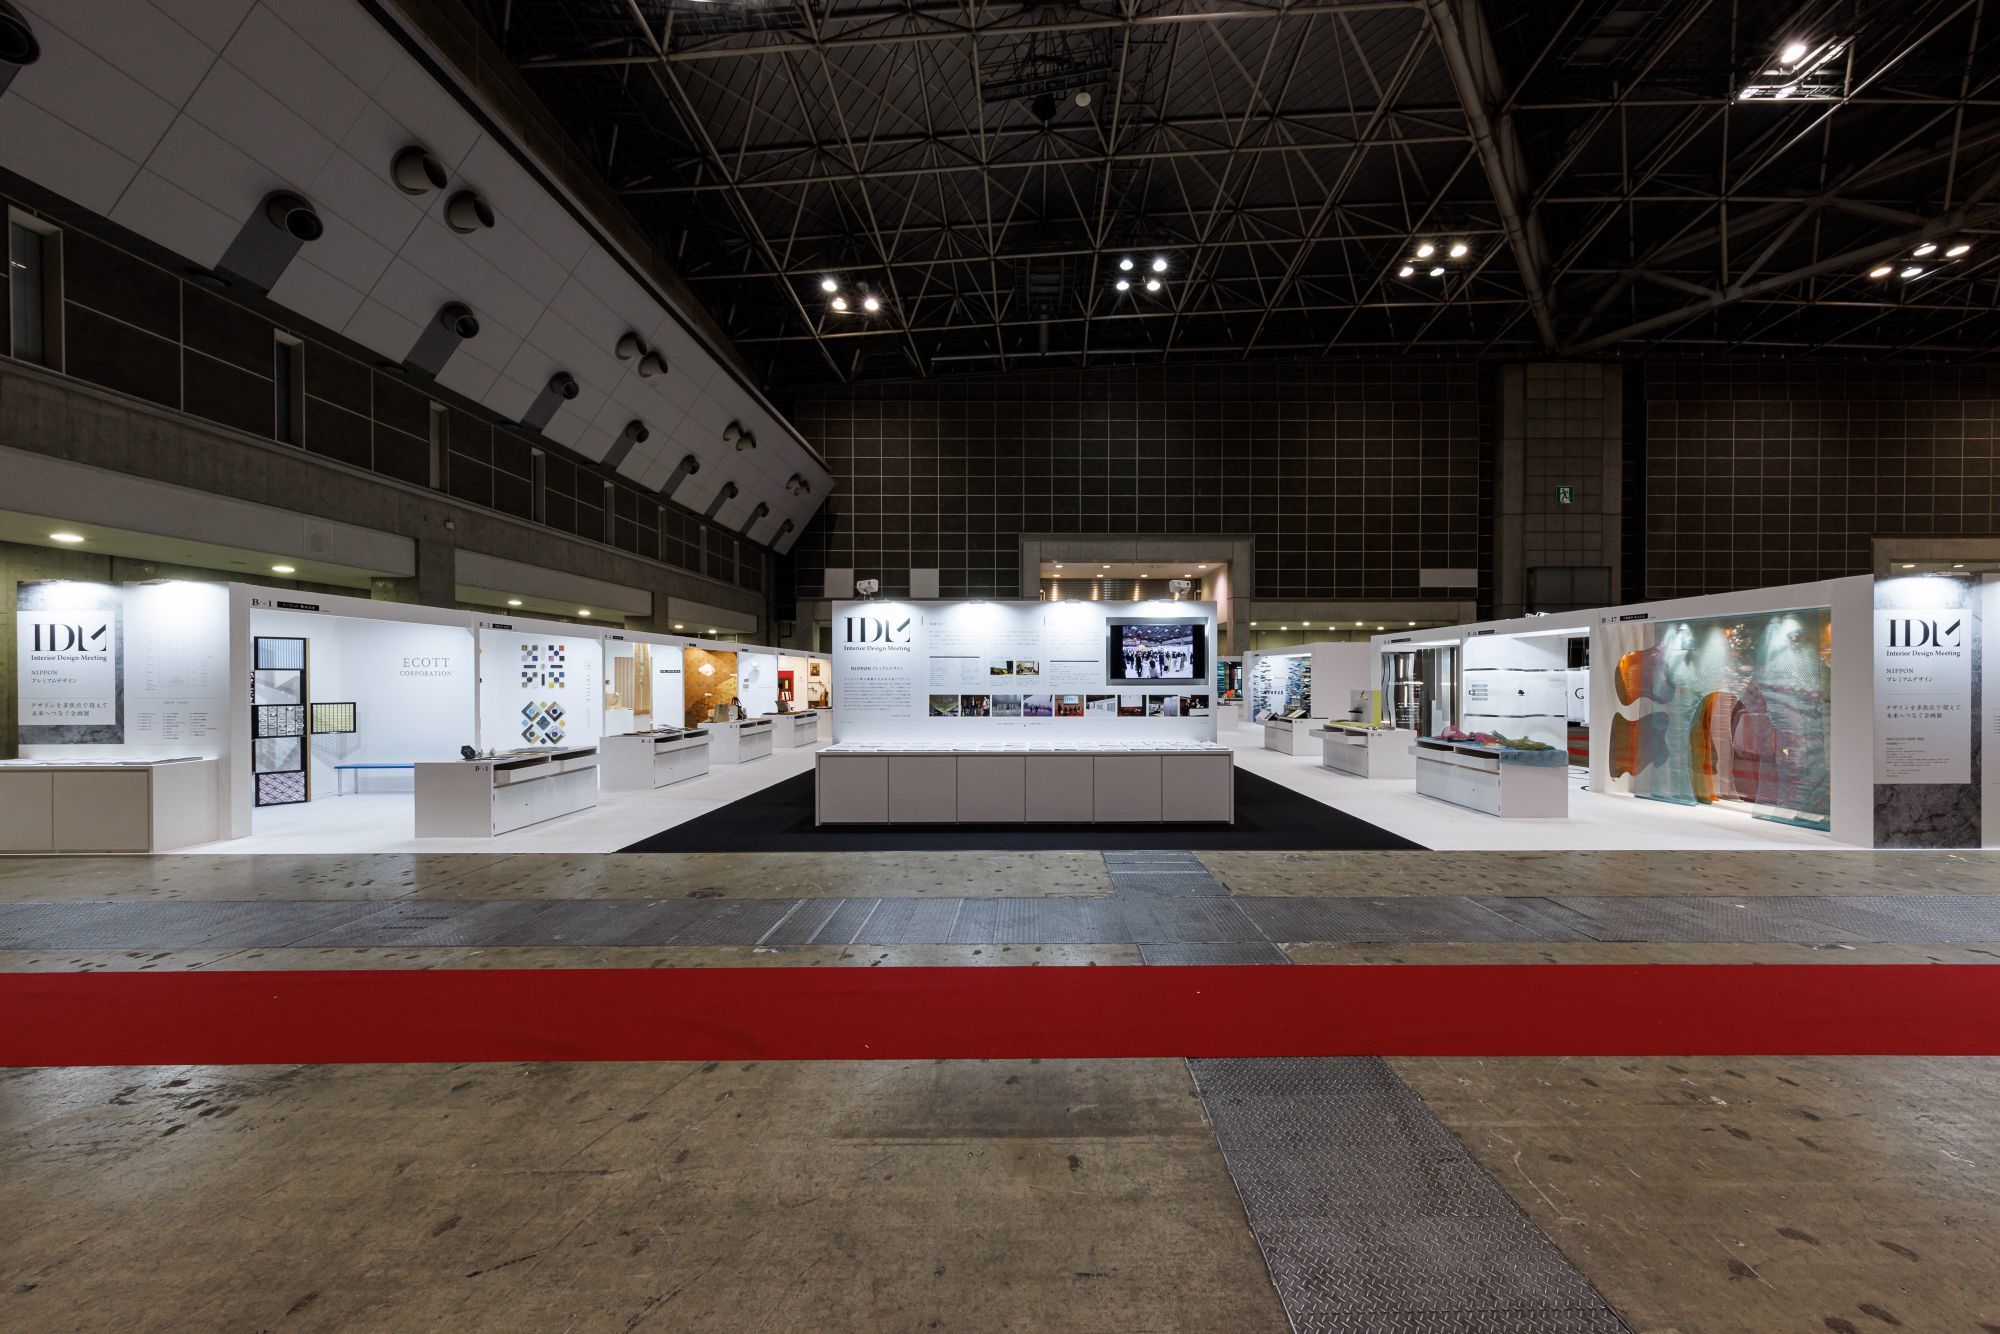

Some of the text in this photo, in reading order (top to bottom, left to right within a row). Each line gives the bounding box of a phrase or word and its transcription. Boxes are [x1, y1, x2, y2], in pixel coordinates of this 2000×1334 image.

[31, 624, 107, 652] IDM
[844, 617, 911, 643] IDM
[1886, 619, 1961, 648] IDM
[57, 654, 80, 662] Design
[80, 654, 107, 662] Meeting
[403, 657, 450, 668] ECOTT
[1912, 650, 1934, 658] Design
[1935, 650, 1961, 658] Meeting
